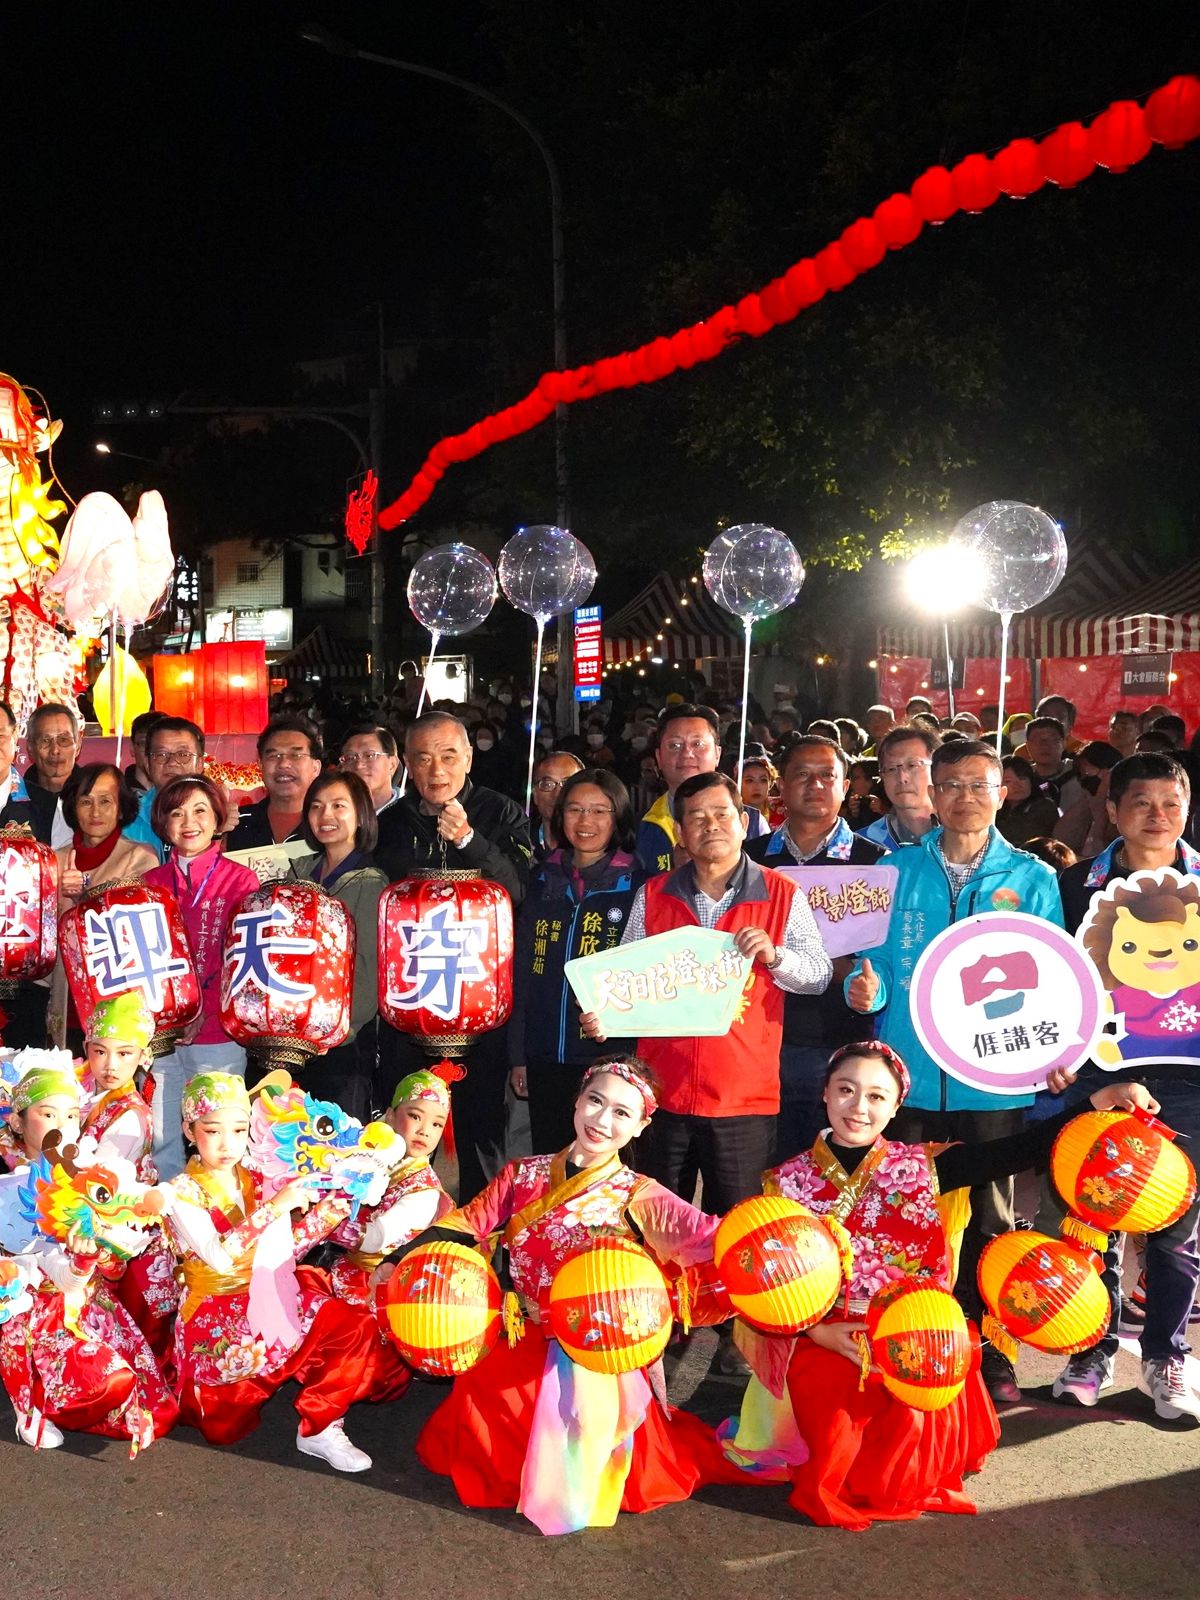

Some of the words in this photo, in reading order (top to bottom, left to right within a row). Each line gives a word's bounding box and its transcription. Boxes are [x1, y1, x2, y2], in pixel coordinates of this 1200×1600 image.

[550, 920, 562, 942] 秘書
[808, 878, 890, 924] 街景燈飾
[85, 902, 190, 1012] 迎
[222, 903, 317, 1011] 天
[386, 902, 490, 1021] 穿
[531, 919, 549, 976] 徐湘茹
